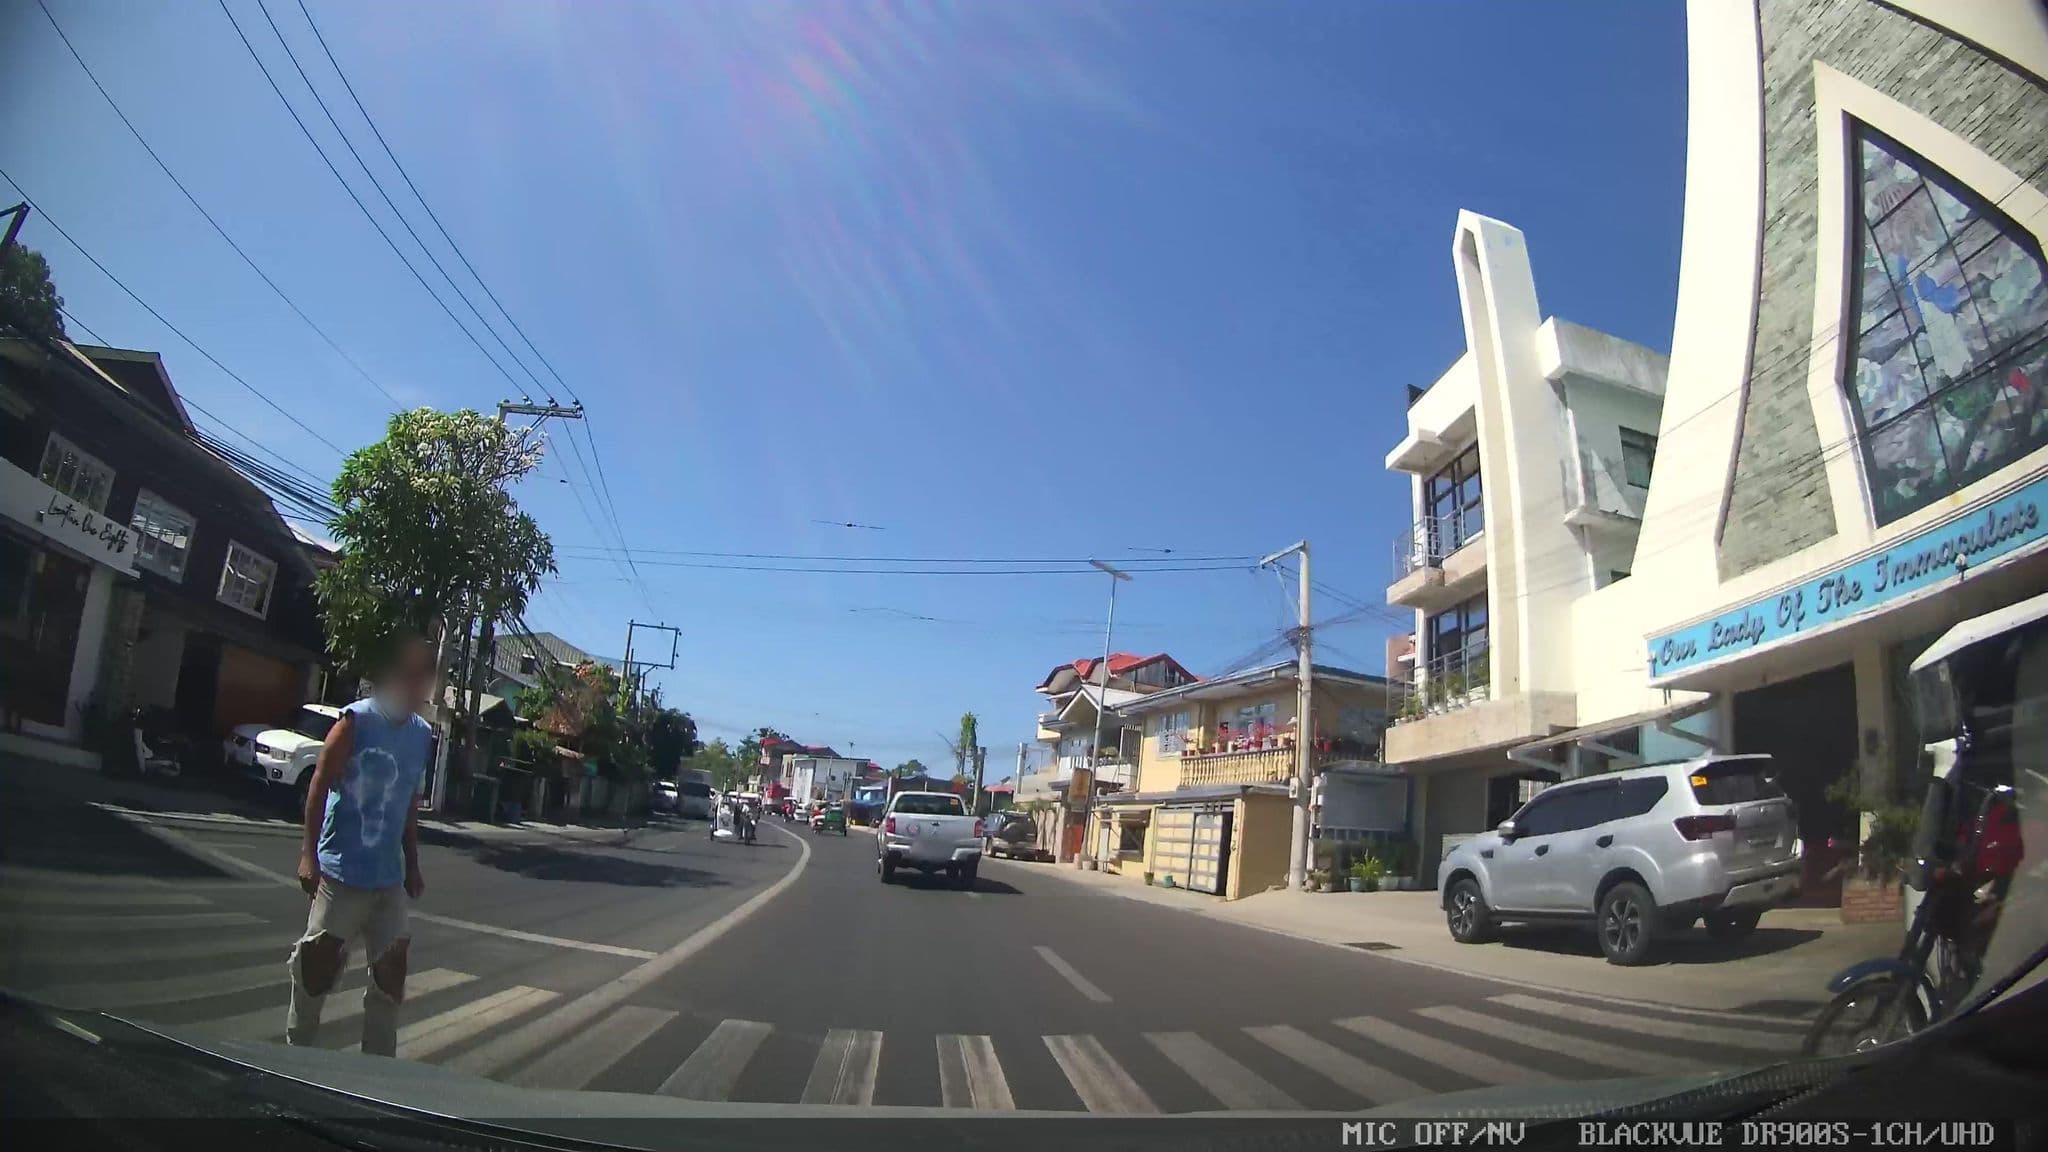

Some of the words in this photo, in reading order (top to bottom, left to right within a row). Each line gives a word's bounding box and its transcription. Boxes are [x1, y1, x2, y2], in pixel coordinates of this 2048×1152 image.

[1661, 638, 1697, 666] Our
[1708, 610, 1765, 651] Lady
[1776, 590, 1805, 631] Of
[1817, 574, 1863, 613] The
[1874, 503, 2040, 592] Immaculate
